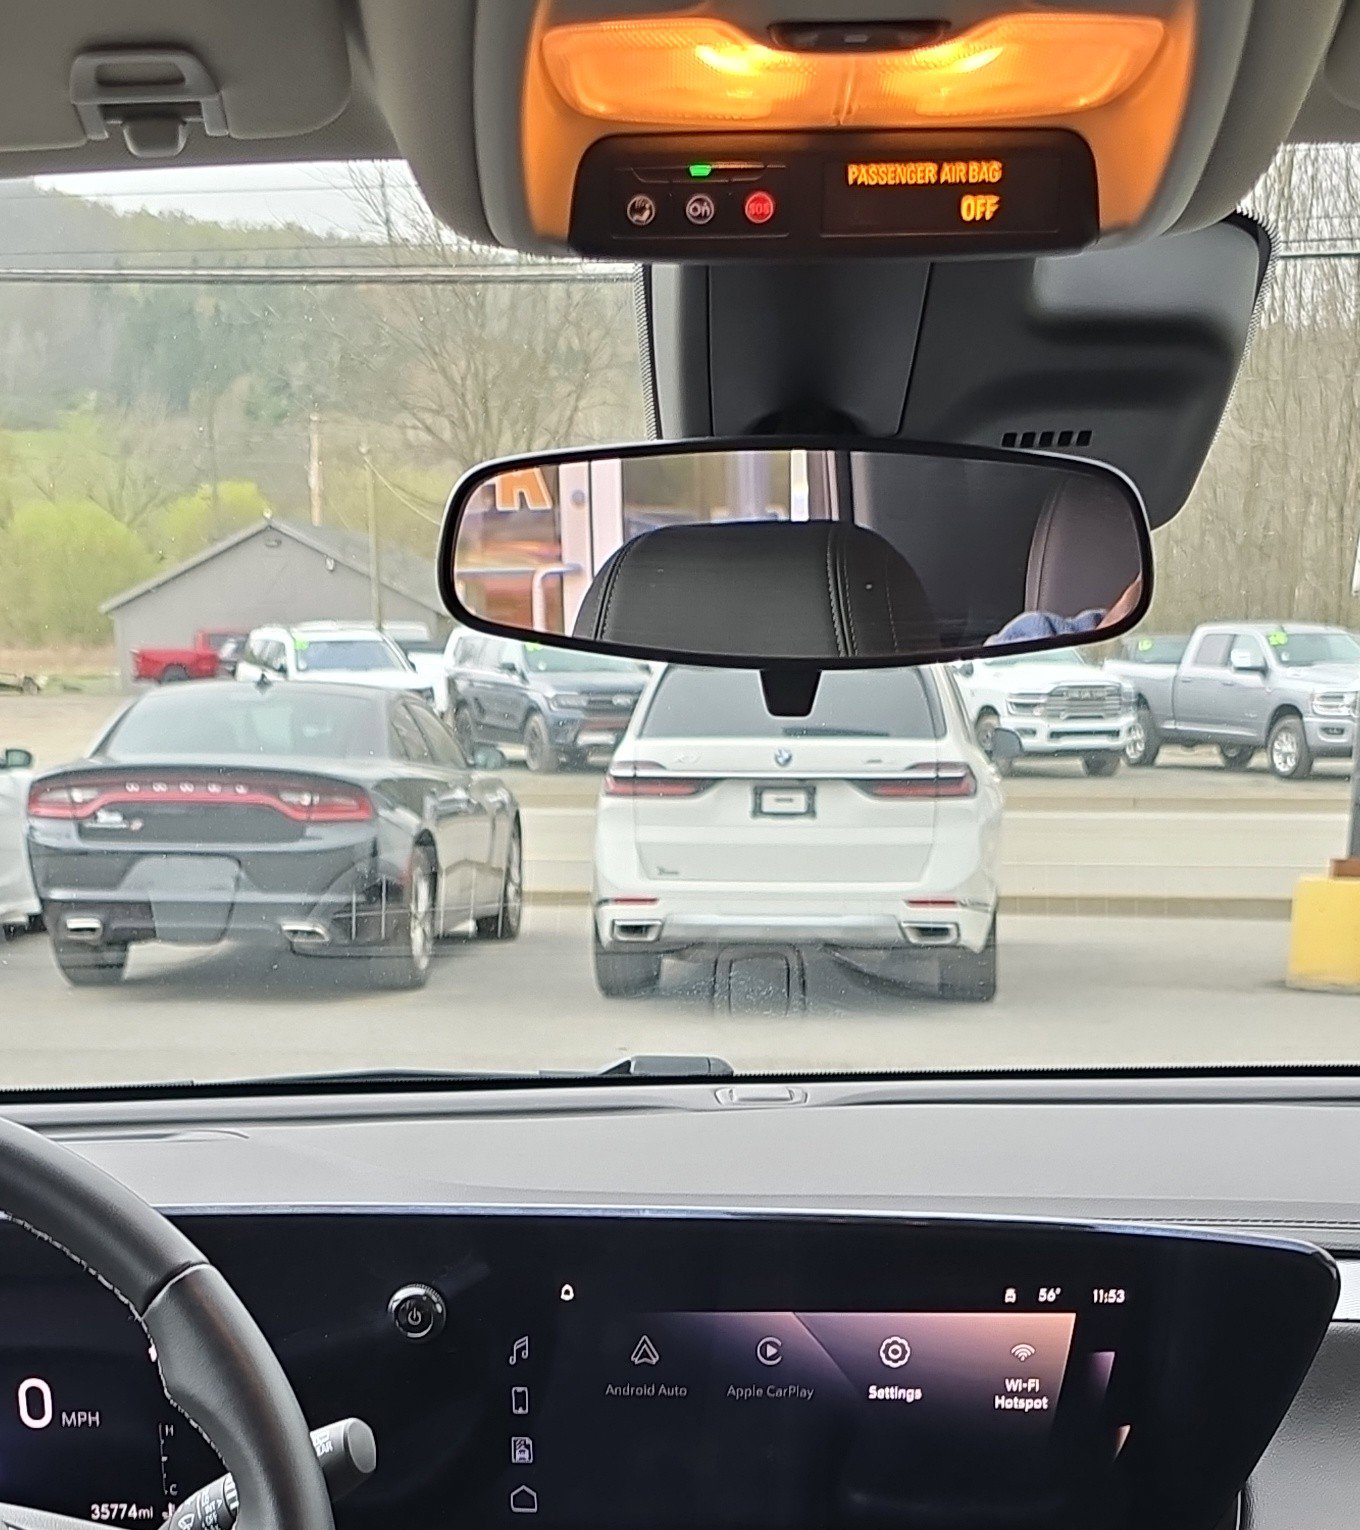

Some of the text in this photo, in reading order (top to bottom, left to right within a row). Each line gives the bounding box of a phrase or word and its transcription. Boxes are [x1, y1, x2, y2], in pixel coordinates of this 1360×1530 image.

[847, 160, 1003, 186] PASSENGER AIR BAG
[748, 202, 770, 216] SOS
[960, 194, 1001, 222] OFF
[1092, 1288, 1126, 1304] 11:53
[605, 1383, 688, 1397] Android Auto
[726, 1384, 815, 1400] Apple CarPlay
[1004, 1378, 1041, 1393] Wi-Fi
[868, 1385, 923, 1403] Settings
[18, 1377, 100, 1429] 0 MPH
[994, 1396, 1049, 1413] Hotspot
[165, 1425, 174, 1436] H
[169, 1484, 178, 1495] C
[205, 1511, 218, 1527] OFF
